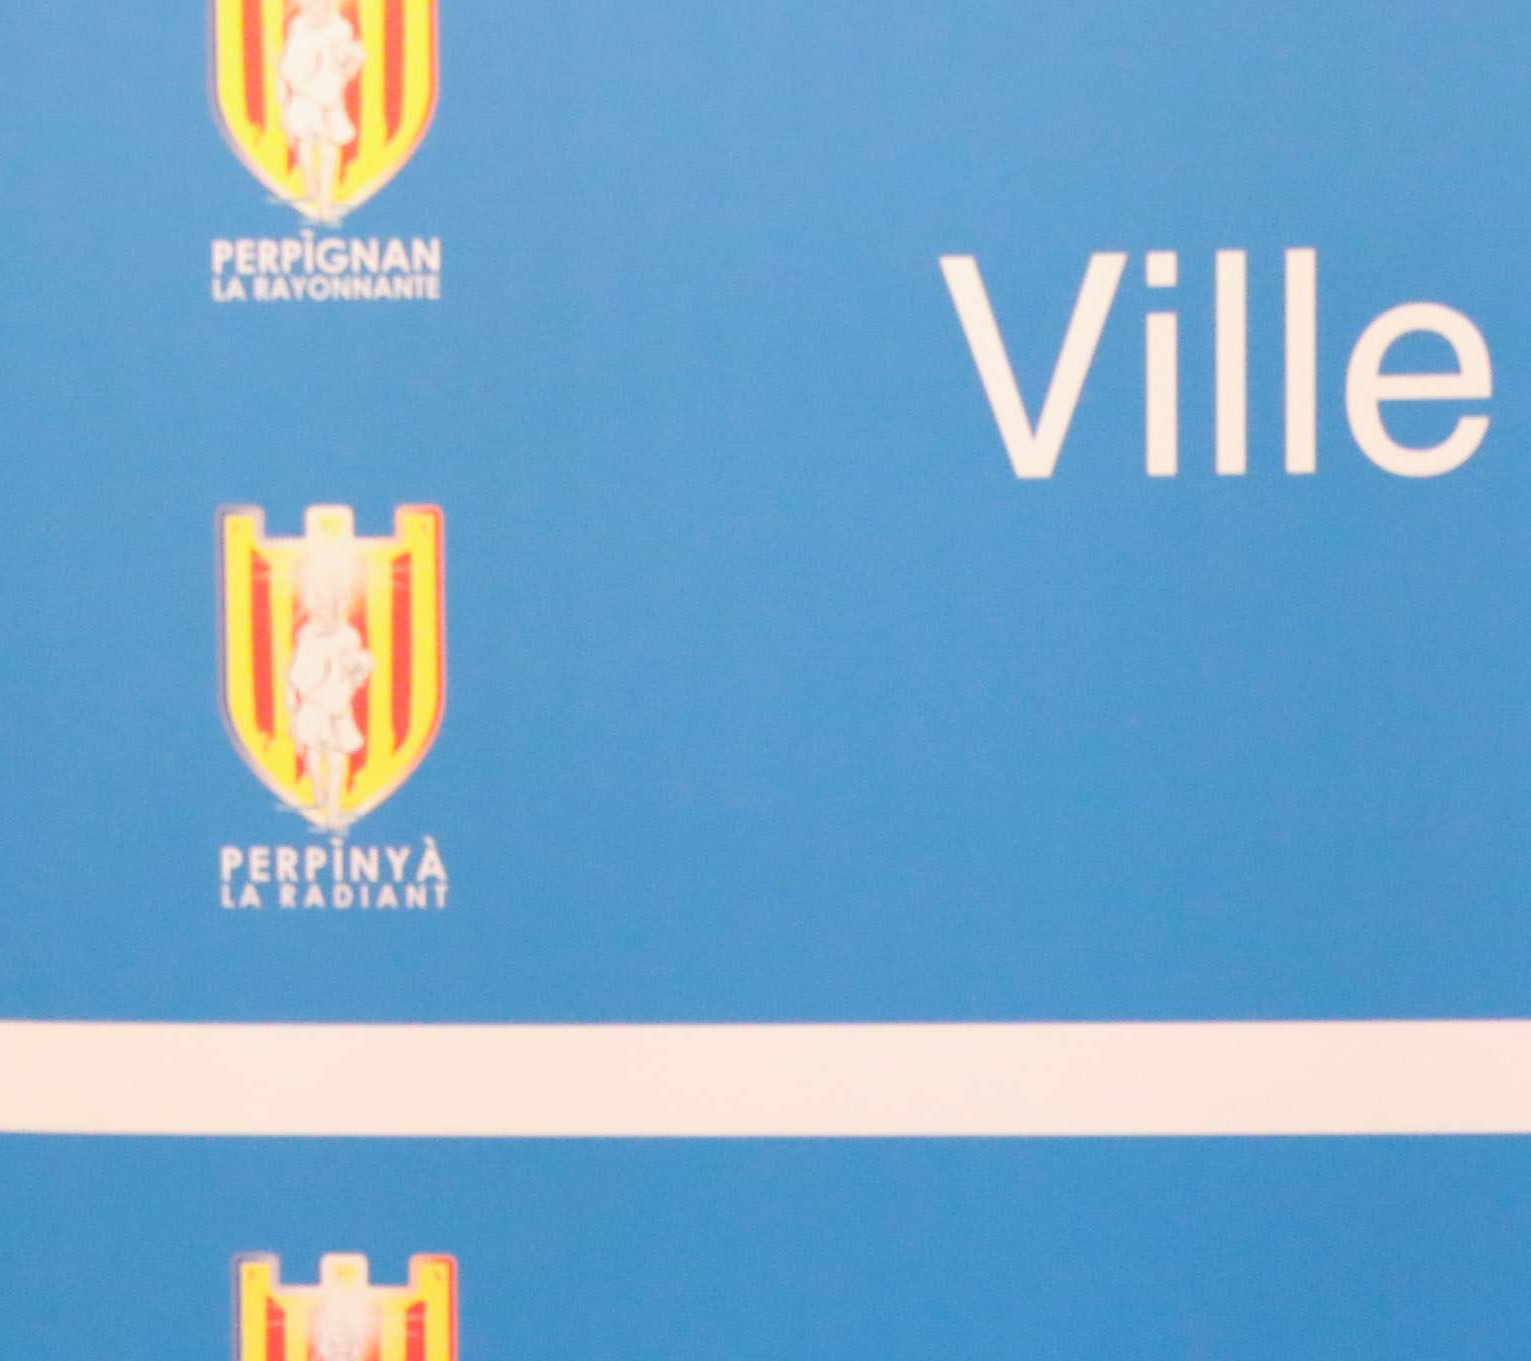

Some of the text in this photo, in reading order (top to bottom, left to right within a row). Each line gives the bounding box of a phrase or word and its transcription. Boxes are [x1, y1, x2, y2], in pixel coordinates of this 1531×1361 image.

[211, 274, 442, 301] LA RAYONNANTE
[941, 247, 1495, 480] Ville
[220, 883, 448, 909] LA RADIANT
